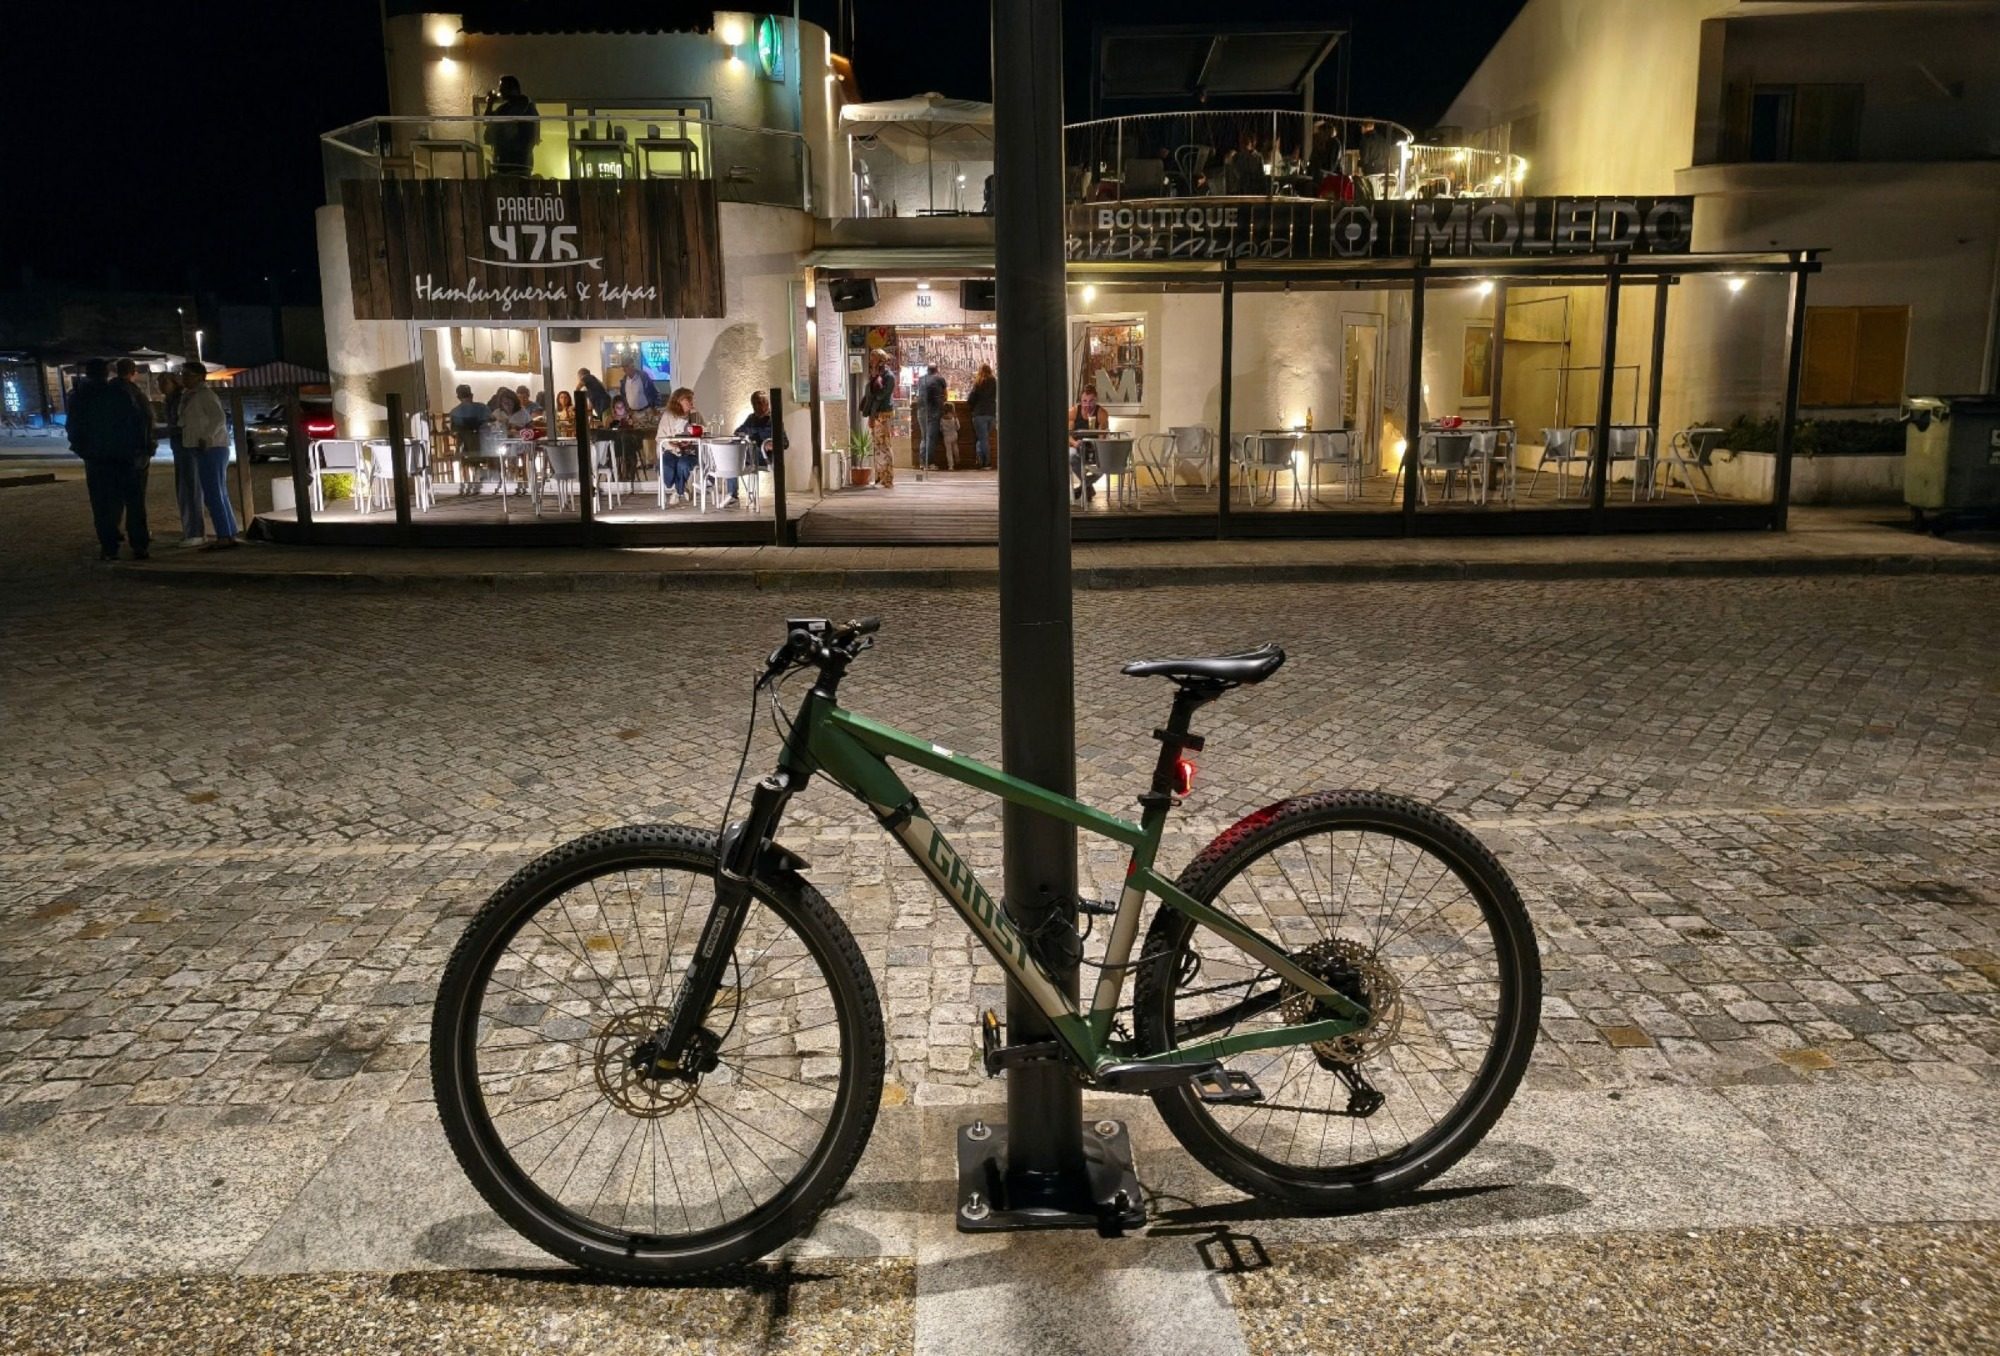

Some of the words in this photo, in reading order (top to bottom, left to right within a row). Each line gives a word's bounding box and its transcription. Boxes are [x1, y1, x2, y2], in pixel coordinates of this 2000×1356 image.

[497, 192, 565, 222] PAREDÃO
[1098, 207, 1238, 232] BOUTIQUE
[489, 225, 578, 261] 476
[1414, 200, 1692, 254] MOLEDO
[415, 273, 568, 312] Hamburgueria
[575, 280, 592, 301] &
[598, 279, 658, 309] tapas
[928, 829, 1028, 972] GHOST
